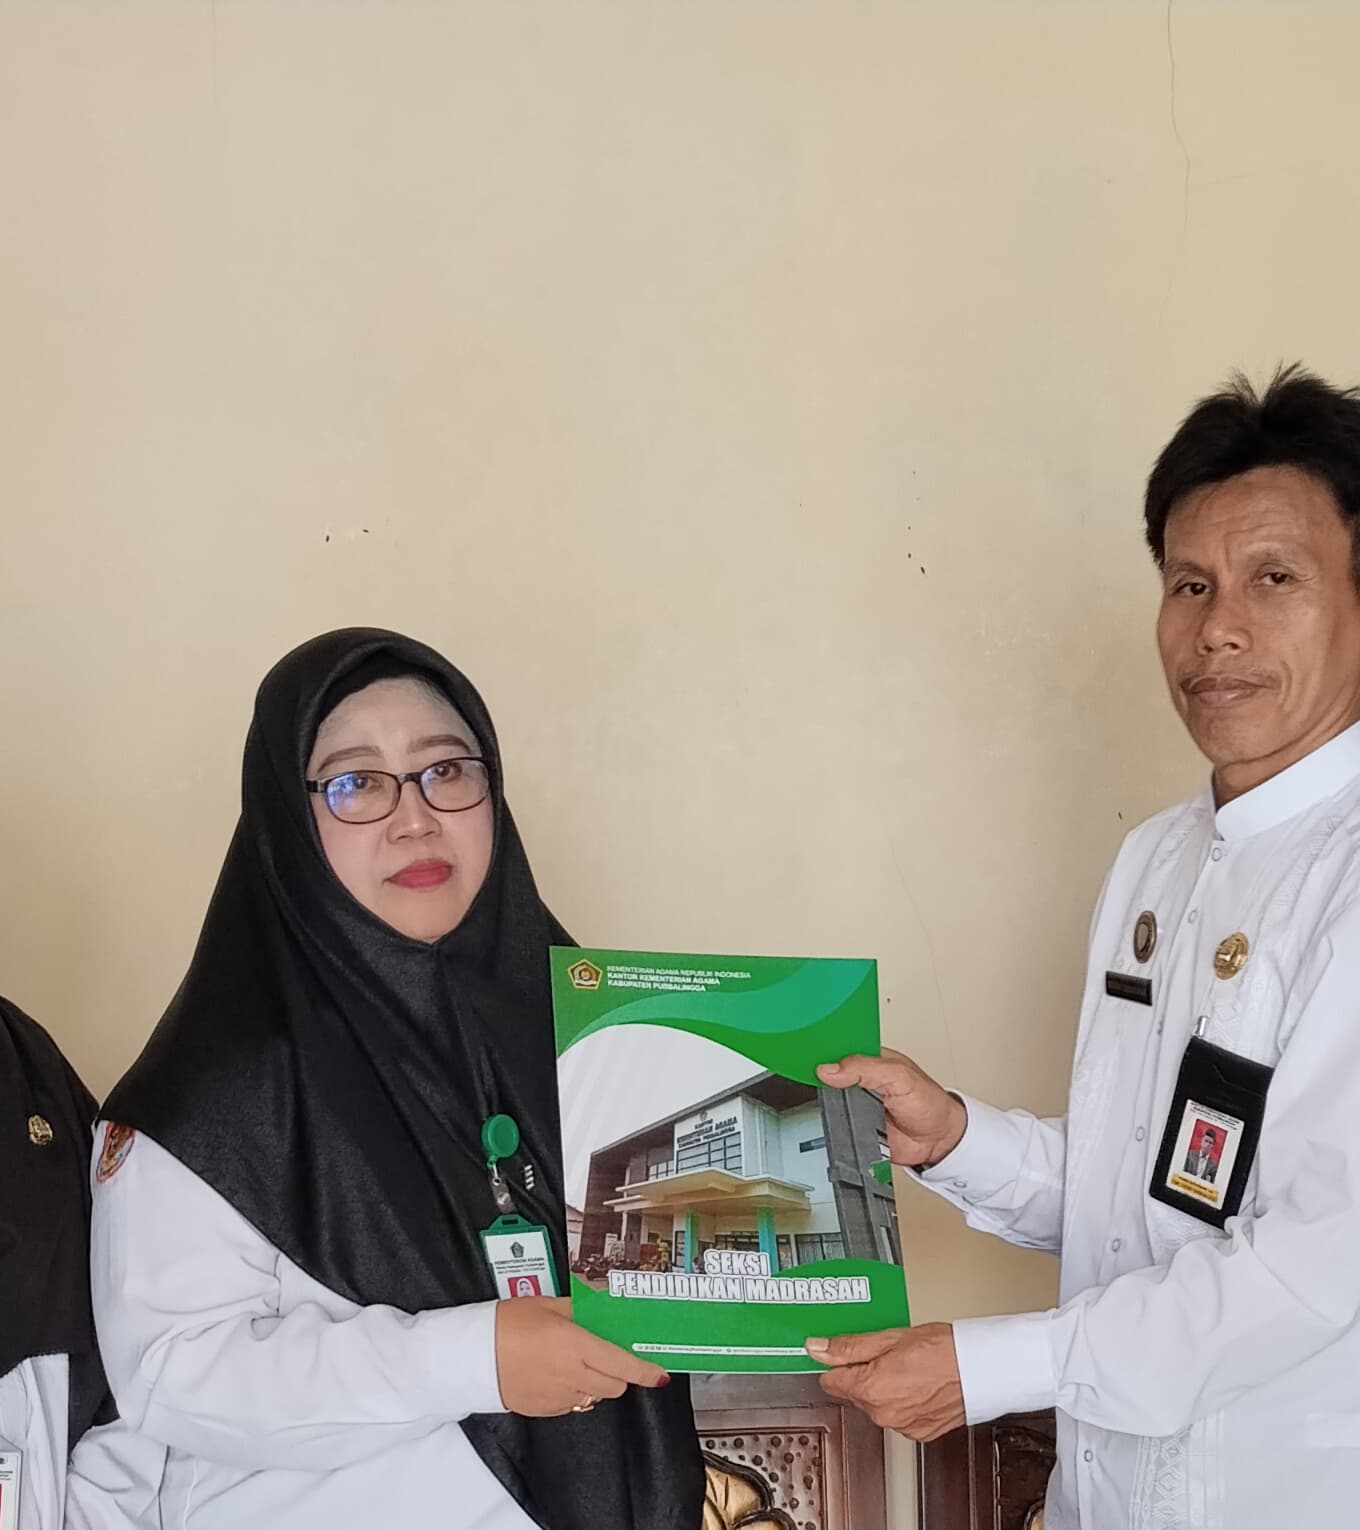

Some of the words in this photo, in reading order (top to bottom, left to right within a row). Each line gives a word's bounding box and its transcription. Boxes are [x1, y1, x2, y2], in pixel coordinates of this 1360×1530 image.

[706, 1251, 768, 1276] SEKSI
[611, 1272, 743, 1299] PENDIDIKAN
[746, 1278, 867, 1301] MADRASAH
